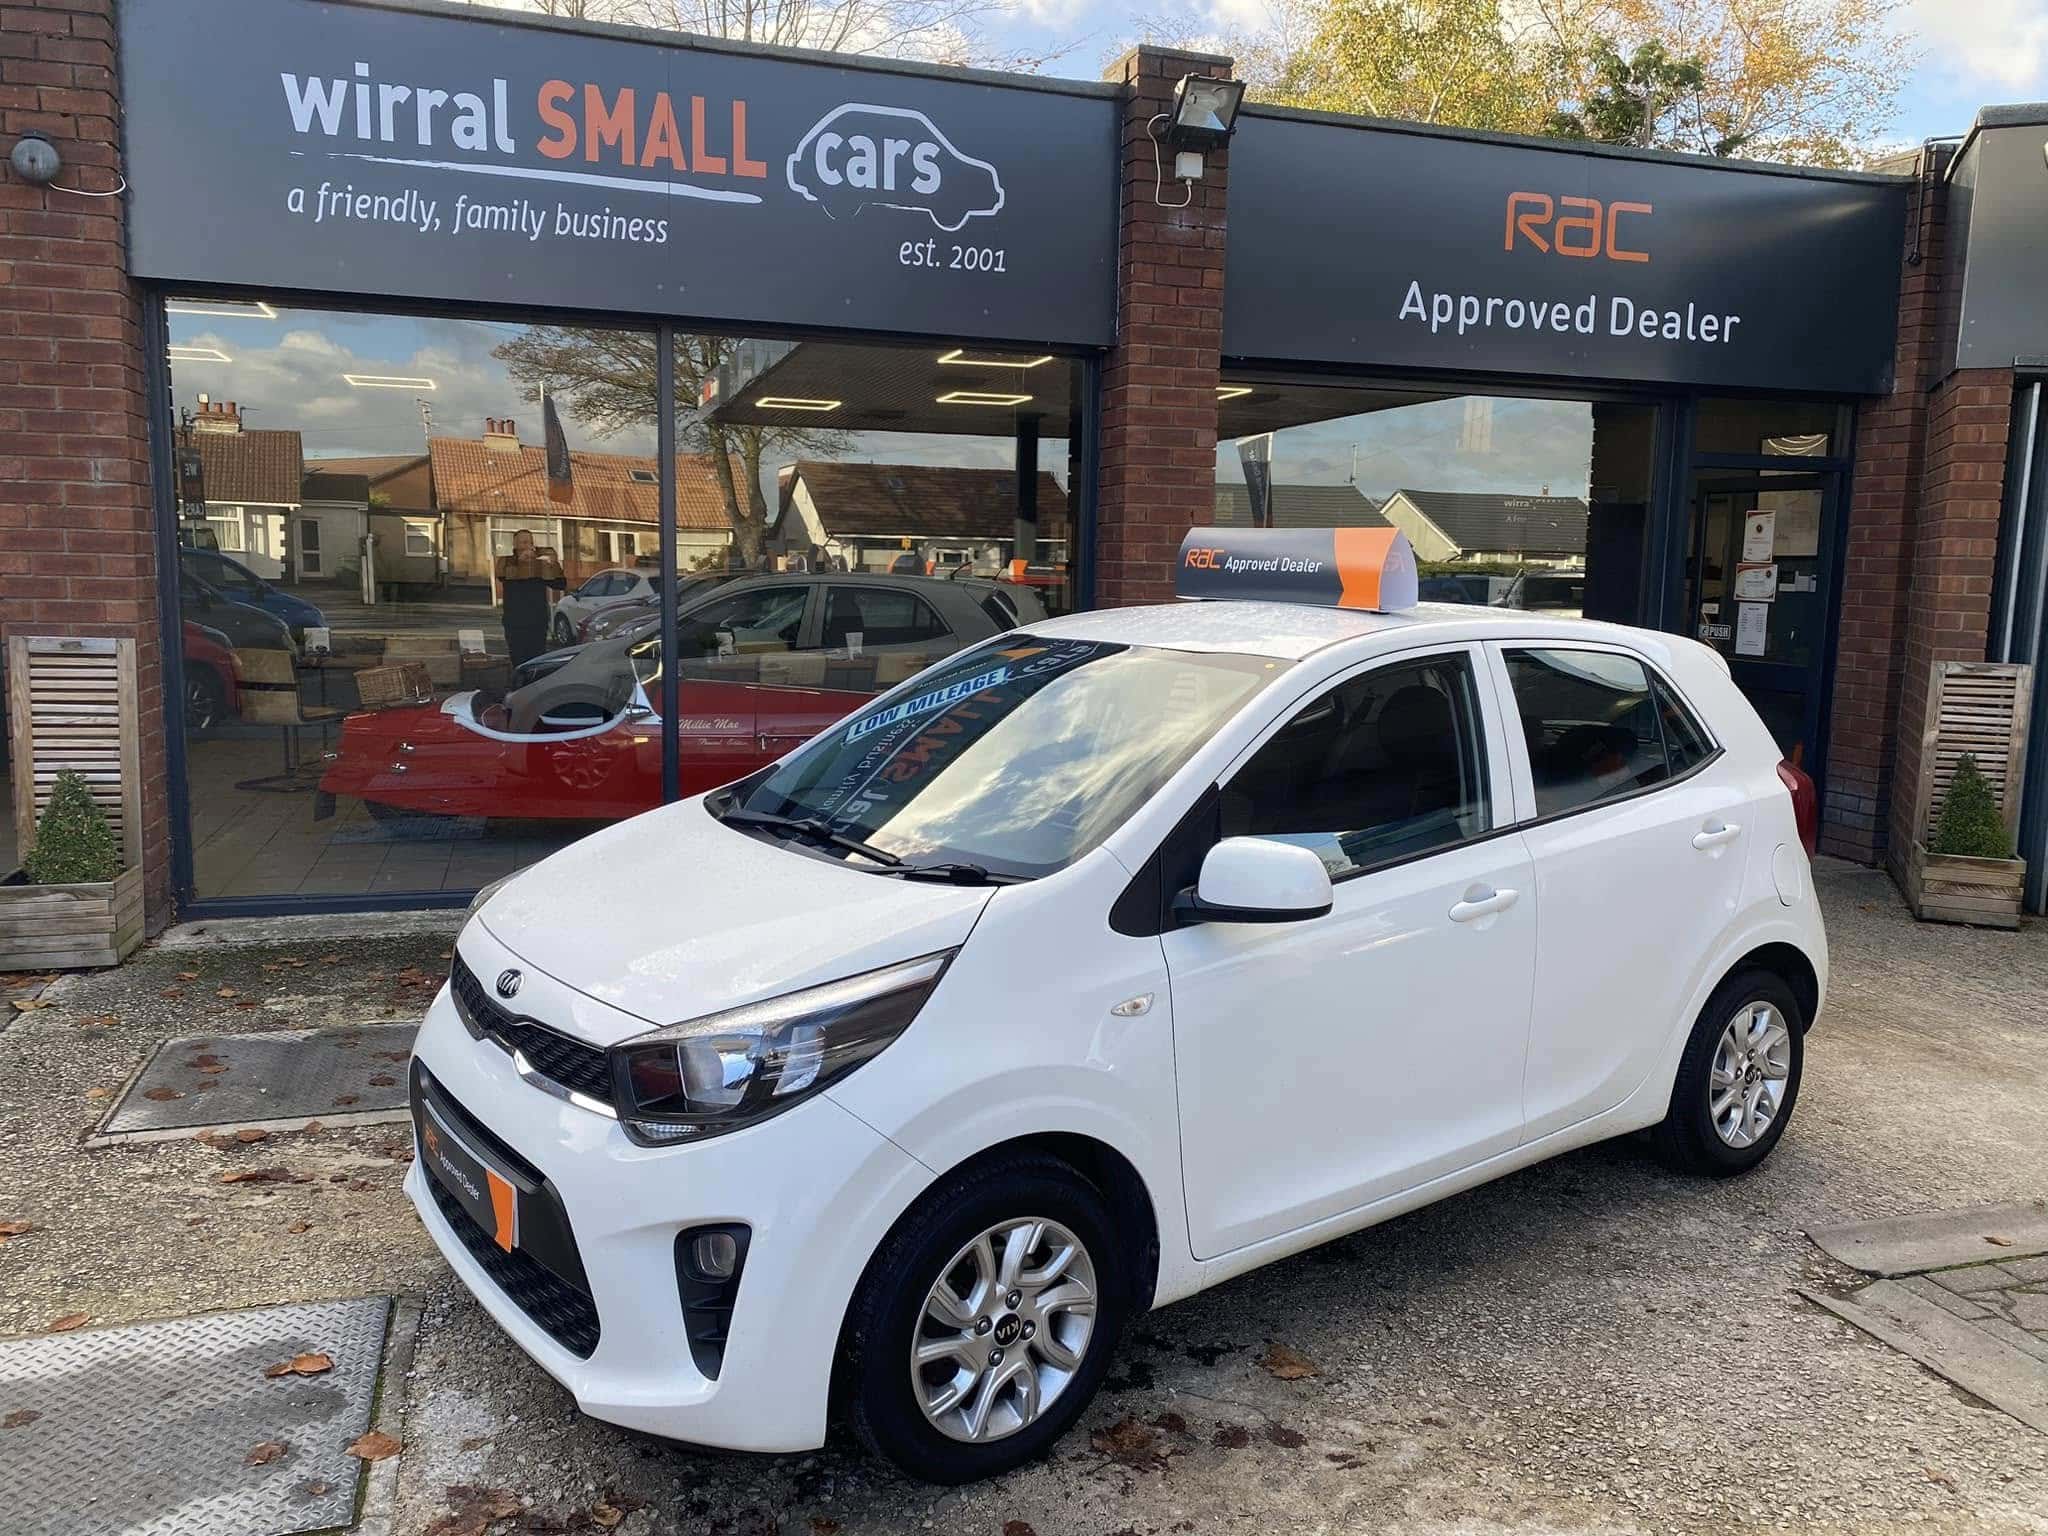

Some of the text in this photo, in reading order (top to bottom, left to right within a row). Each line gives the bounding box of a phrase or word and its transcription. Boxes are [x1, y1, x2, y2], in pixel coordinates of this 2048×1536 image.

[280, 61, 767, 179] wirral SMALL
[814, 131, 942, 196] cars
[287, 181, 669, 244] a friendly, family business
[1503, 190, 1653, 264] RAC
[899, 236, 1007, 273] est. 2001
[1398, 280, 1742, 344] Approved Dealer
[1184, 548, 1323, 574] RAC Approved Dealer
[853, 670, 1001, 736] LOW MILEAGE
[439, 1150, 463, 1184] Approved
[462, 1173, 480, 1201] Dealer
